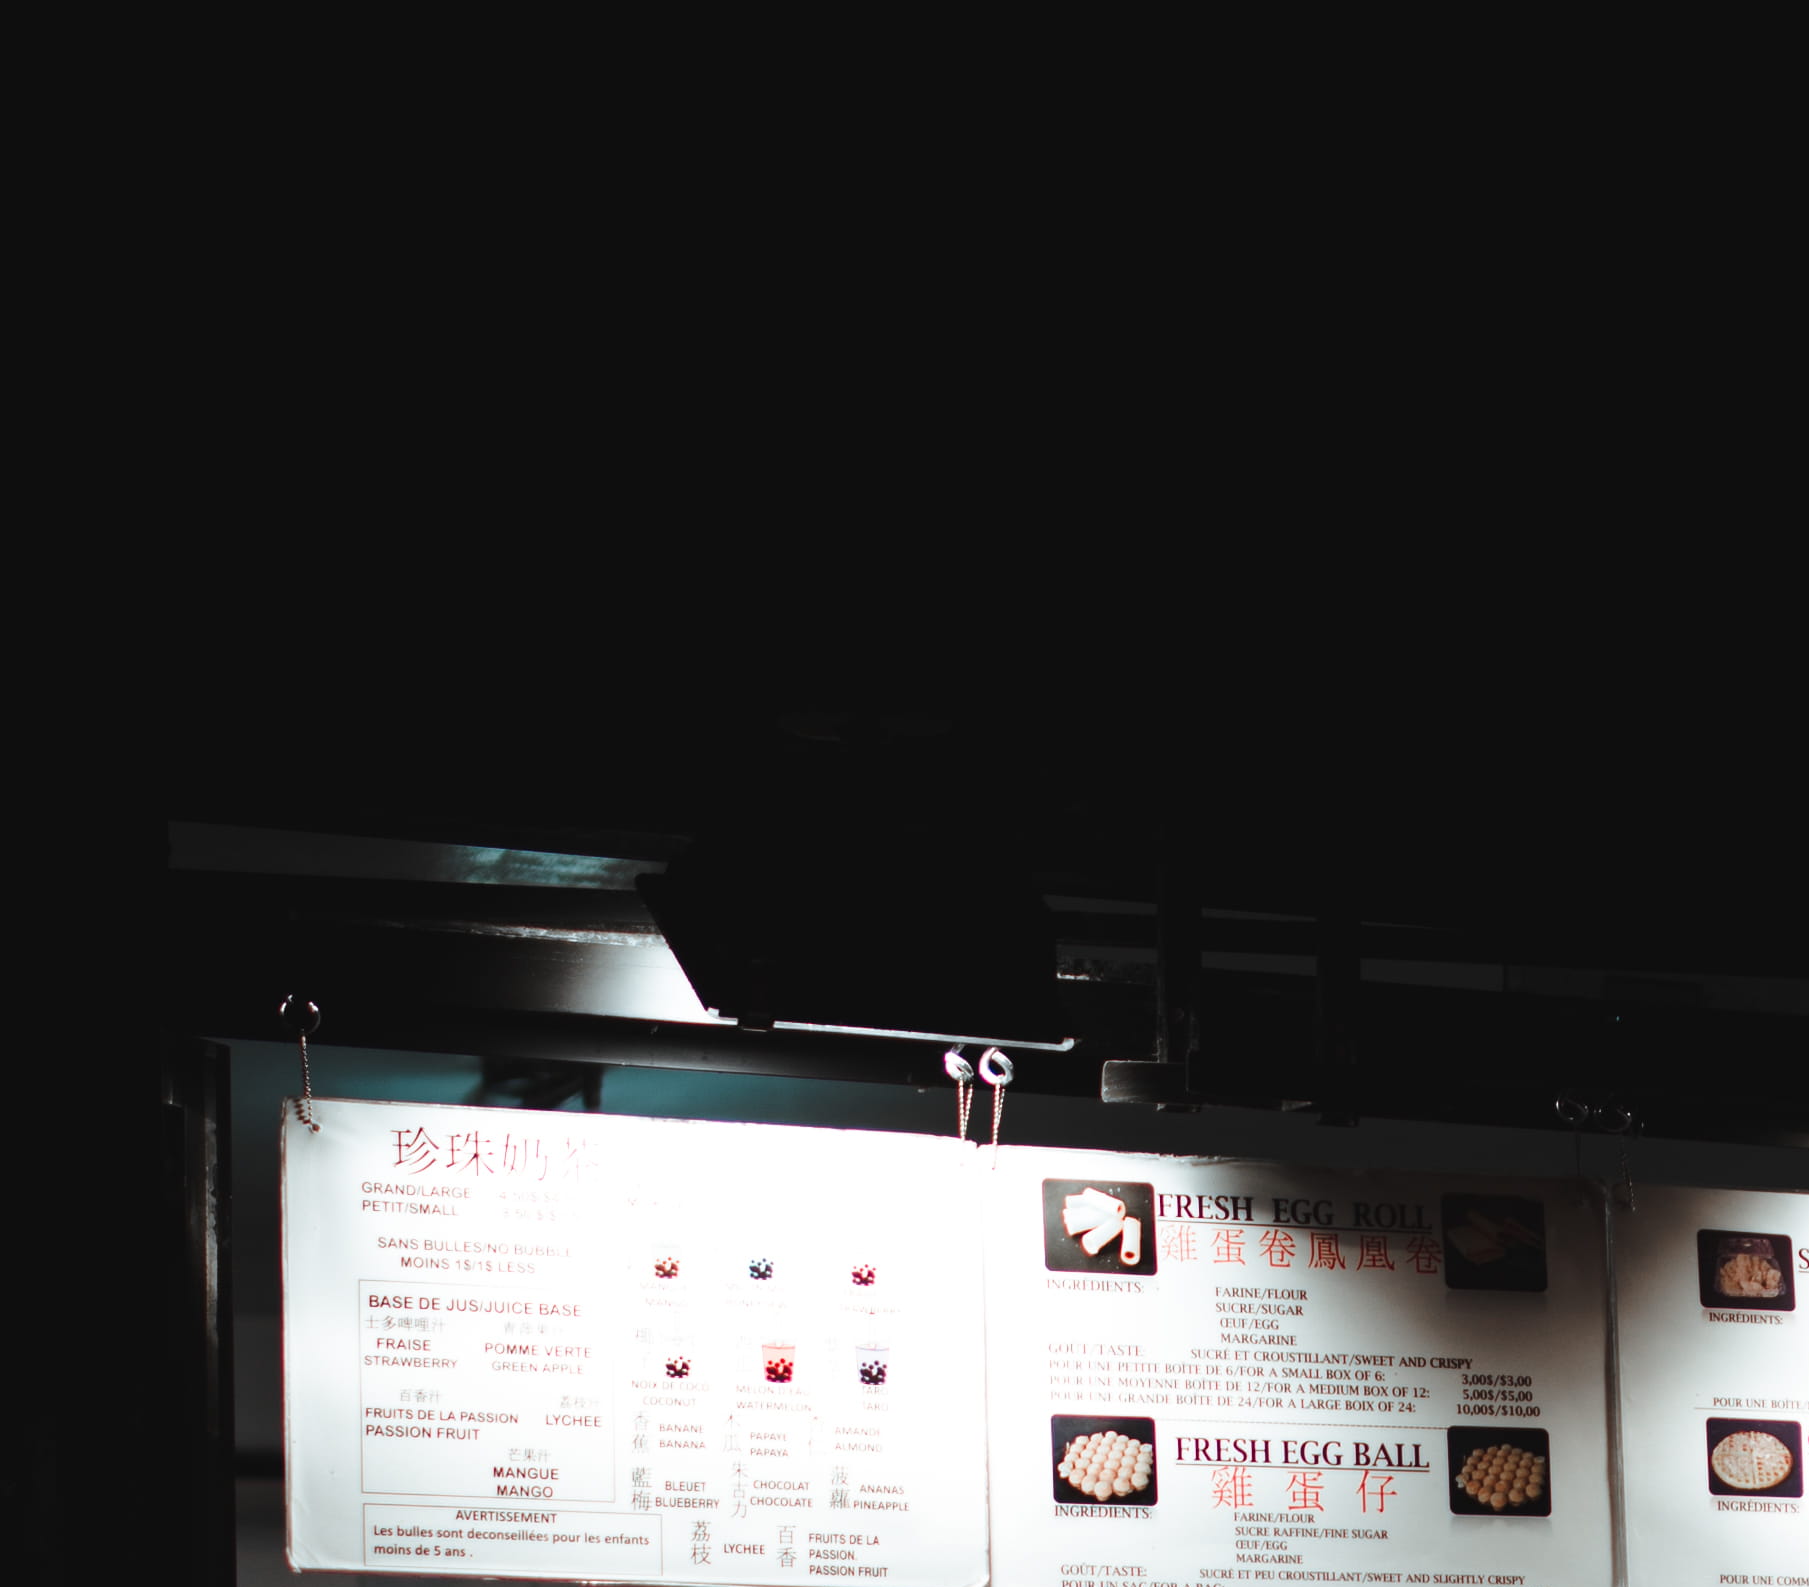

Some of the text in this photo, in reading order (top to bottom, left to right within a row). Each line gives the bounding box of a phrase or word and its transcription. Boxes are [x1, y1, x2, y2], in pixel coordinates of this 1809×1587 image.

[361, 1181, 471, 1199] GRAND/LARGE
[362, 1199, 459, 1217] PETIT/SMALL
[1158, 1192, 1433, 1231] FRESH EGG ROLL
[377, 1236, 419, 1251] SANS
[400, 1256, 450, 1270] MOINS
[1214, 1286, 1309, 1301] FARINE/FLOUR
[368, 1294, 582, 1317] BASE DE JUS/JUICE BASE
[1214, 1302, 1304, 1317] SUCRE/SUGAR
[376, 1337, 431, 1352] FRAISE
[1220, 1333, 1298, 1347] MARGARINE
[484, 1342, 592, 1359] POMME VERTE
[1190, 1346, 1473, 1370] SUCRÉ CROUSTILLANT/SWEET AND CRISPY
[363, 1354, 458, 1369] STRAWBERRY
[491, 1361, 584, 1375] GREEN APPLE
[1281, 1366, 1352, 1381] SMALL BOX
[1461, 1373, 1533, 1388] 3,00$/$3,00
[1461, 1387, 1534, 1403] 5,00$/$5,00
[365, 1407, 519, 1425] FRUITS DE LA PASSION
[1455, 1403, 1541, 1418] 10,00$/$10,00
[545, 1414, 603, 1428] LYCHEE
[365, 1424, 480, 1441] PASSION FRUIT
[1175, 1436, 1431, 1468] FRESH EGG BALL
[492, 1466, 560, 1480] MANGUE
[496, 1484, 554, 1499] MANGO
[664, 1480, 707, 1493] BLEUET
[752, 1479, 810, 1492] CHOCOLAT
[859, 1484, 906, 1496] ANANAS
[1210, 1465, 1398, 1514] 雞蛋仔
[654, 1496, 720, 1510] BLUEBERRY
[749, 1495, 814, 1509] CHOCOLATE
[853, 1500, 910, 1512] PINEAPPLE
[455, 1509, 558, 1524] AVERTISSEMENT
[1233, 1512, 1316, 1524] FARINE/FLOUR
[373, 1525, 650, 1546] Les bulles sont deconseillées pour les enfants
[808, 1533, 847, 1545] FRUITS
[1234, 1526, 1389, 1540] SUCRE RAFFINE/FINE SUGAR
[373, 1543, 431, 1557] moins de
[723, 1543, 765, 1556] LYCHEE
[1235, 1553, 1304, 1565] MARGARINE
[808, 1564, 889, 1578] PASSION FRUIT
[1278, 1570, 1526, 1586] CROUSTILLANT/SWEET AND SLIGHTLY CRISPY
[1719, 1574, 1750, 1587] POUR
[1752, 1575, 1774, 1587] UNE
